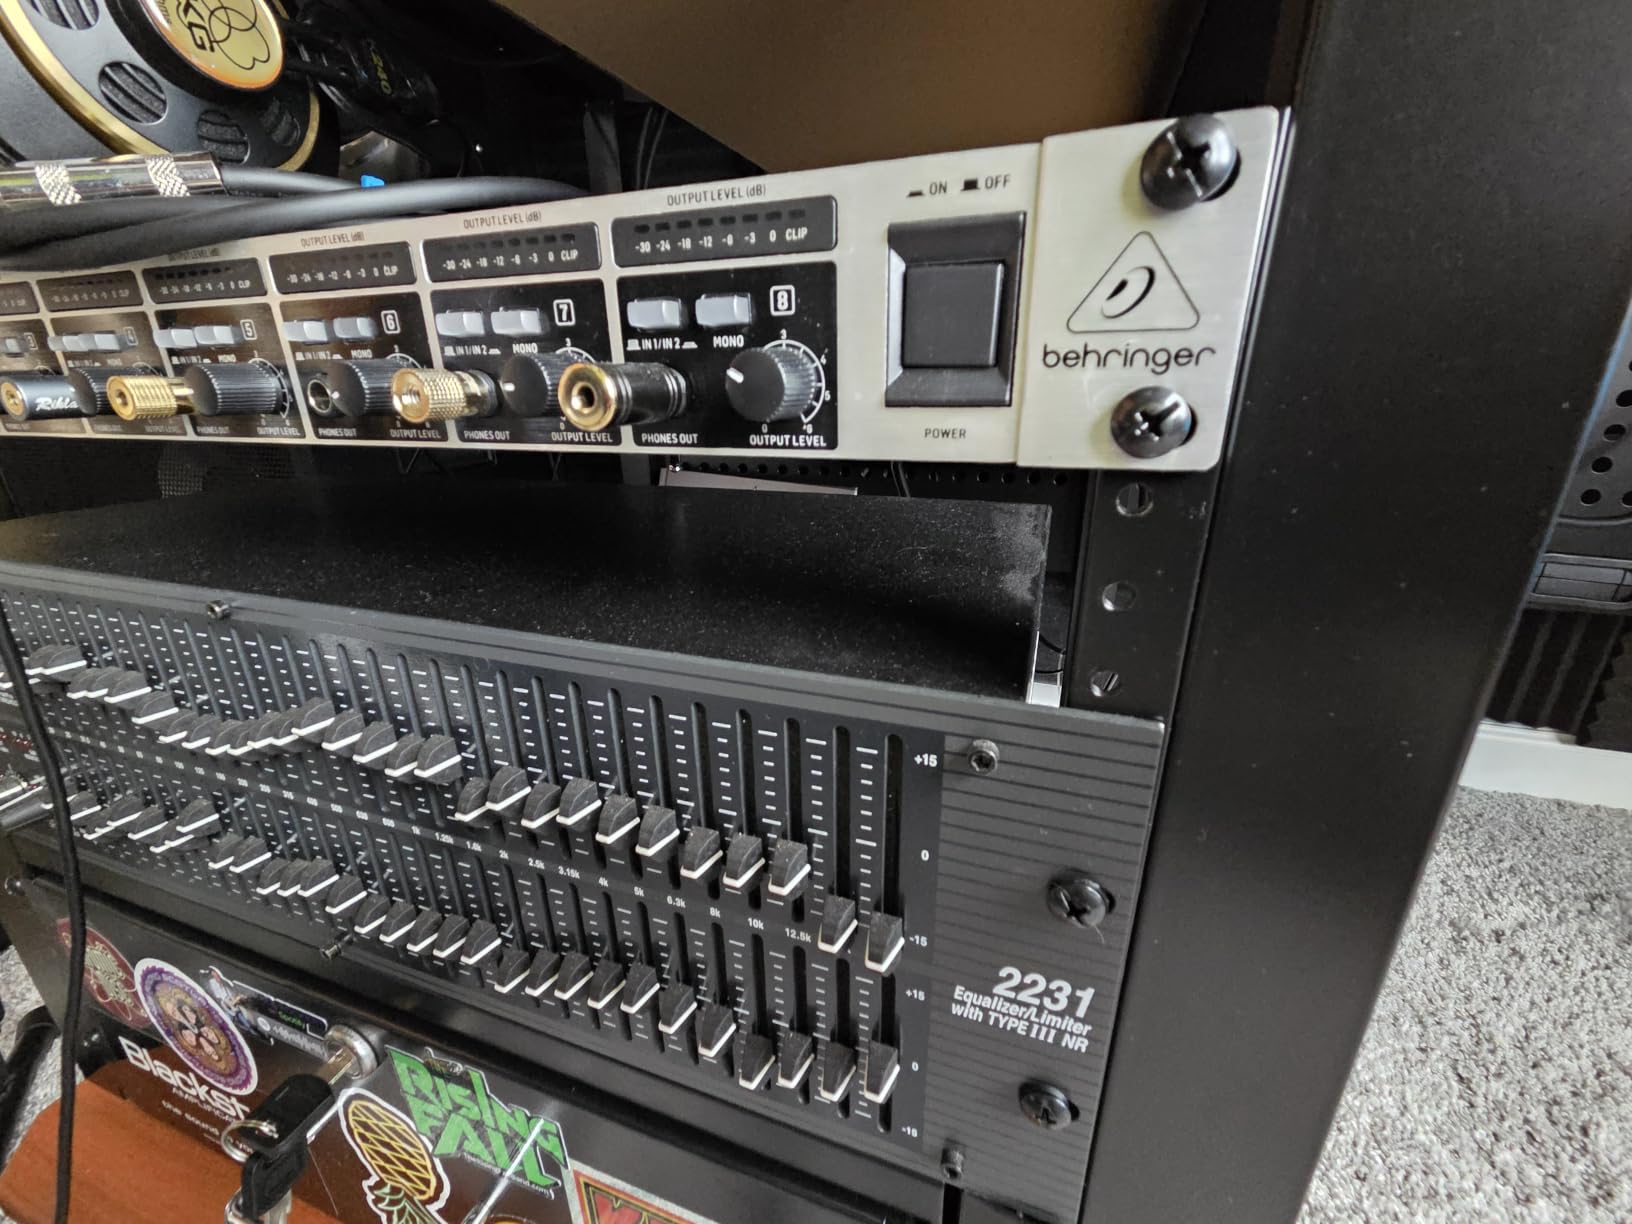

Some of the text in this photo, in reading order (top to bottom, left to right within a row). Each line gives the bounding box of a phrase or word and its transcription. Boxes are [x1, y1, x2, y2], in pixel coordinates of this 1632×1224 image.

[929, 175, 1012, 195] ON OFF
[667, 184, 767, 206] OUTPUT LEVEL (dB)
[463, 210, 541, 229] OUTPUT LEVEL (dB)
[300, 235, 328, 247] OUTPUT
[328, 232, 350, 245] LEVEL
[635, 240, 650, 253] -30
[656, 239, 671, 251] -24
[699, 236, 713, 248] -12
[744, 232, 756, 244] -3
[769, 230, 776, 242] 0
[786, 227, 808, 241] CLIP
[560, 249, 578, 261] CLIP
[780, 328, 787, 340] 3
[713, 335, 745, 348] MONO
[351, 349, 373, 359] MONO
[512, 343, 538, 354] MONO
[1043, 343, 1216, 375] behringer
[390, 429, 441, 439] OUTPUT LEVEL
[464, 430, 510, 440] PHONES OUT
[552, 432, 613, 443] OUTPUT LEVEL
[641, 432, 698, 444] PHONES OUT
[924, 427, 966, 440] POWER
[749, 434, 827, 447] OUTPUT LEVEL
[914, 753, 938, 768] +15
[920, 849, 930, 861] 0
[499, 850, 509, 860] 2k
[527, 857, 545, 870] 2.5k
[558, 866, 580, 879] 3.15k
[598, 877, 609, 887] 4k
[633, 886, 645, 897] 5k
[709, 907, 721, 918] 8k
[747, 917, 765, 930] 10k
[784, 927, 812, 943] 12.5k
[908, 934, 928, 947] -15
[905, 988, 925, 1001] +15
[992, 966, 1095, 1018] 2231
[953, 984, 1092, 1036] Equalizer/Limiter
[951, 1002, 1088, 1053] with TYPE III NR
[118, 1036, 250, 1120] Blackst
